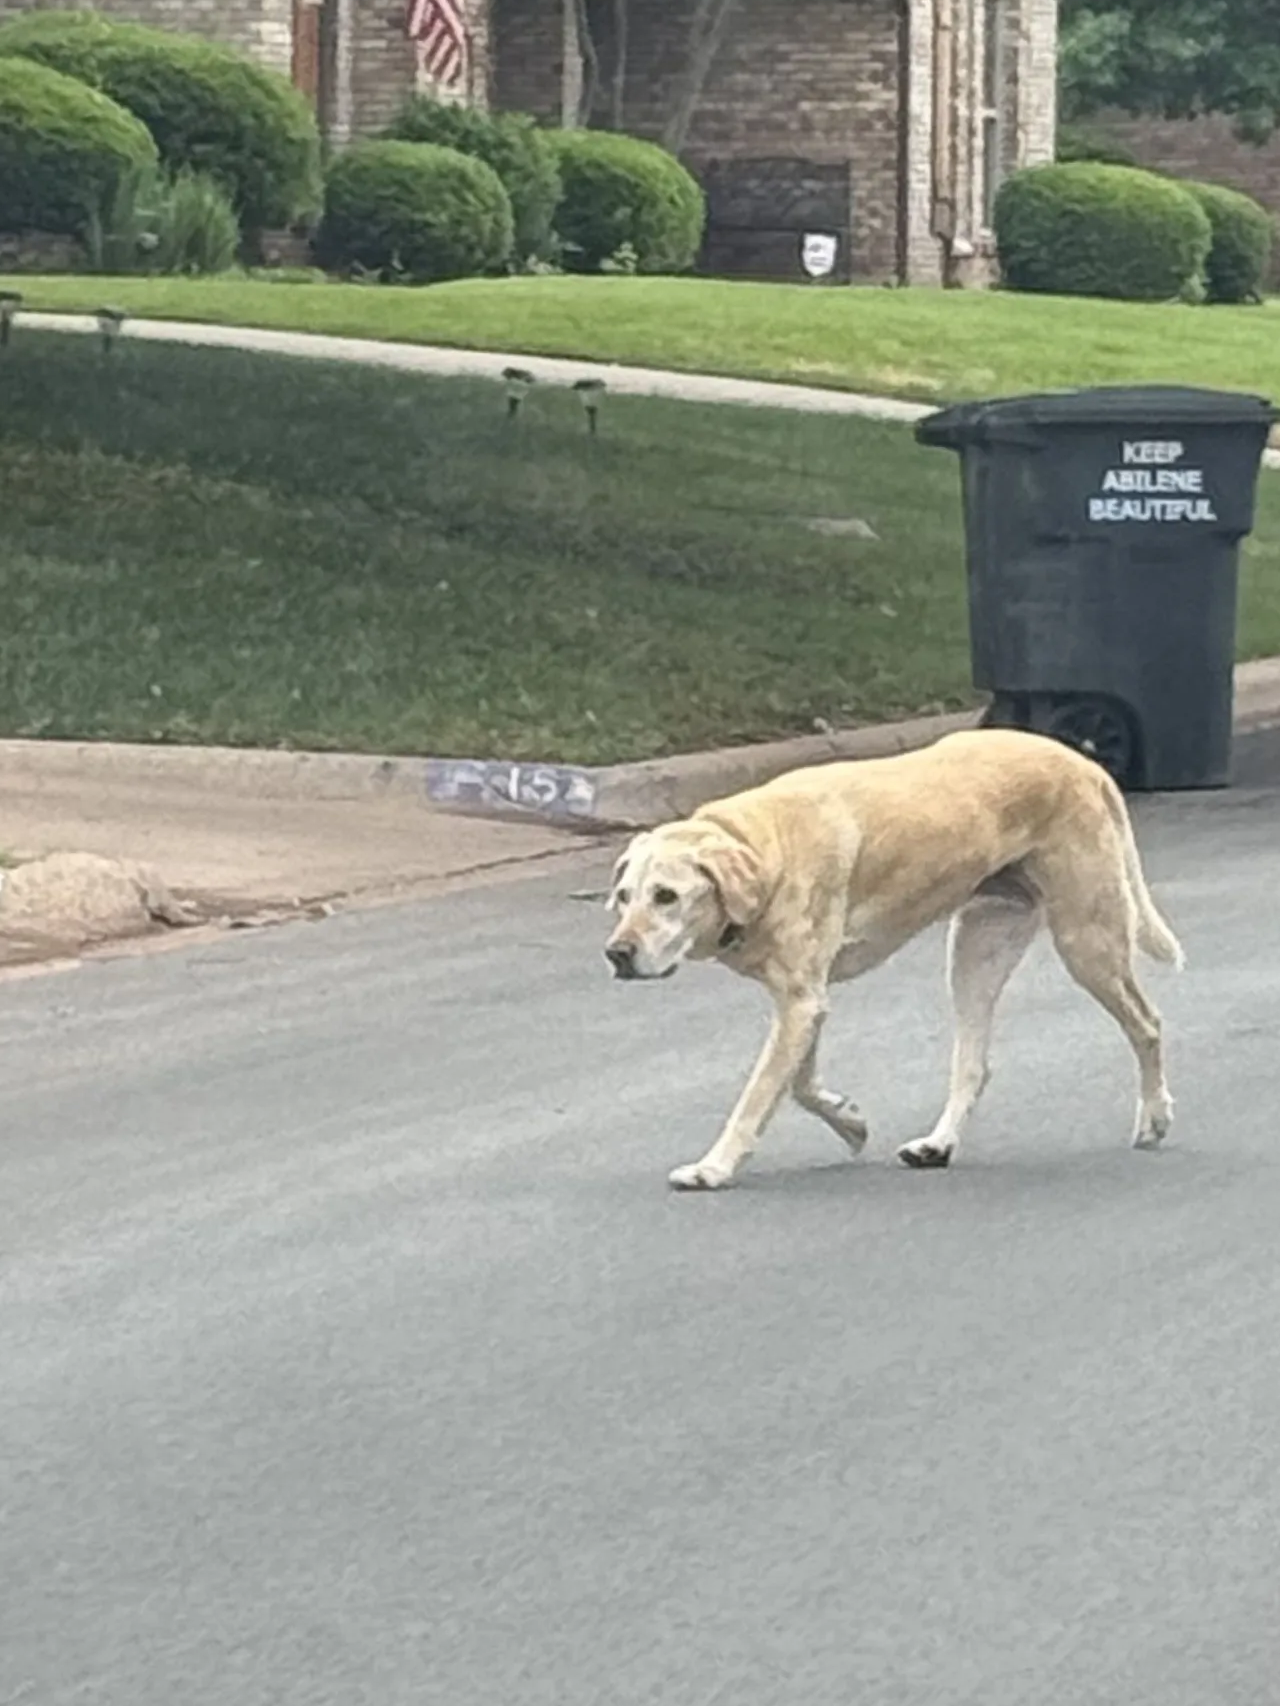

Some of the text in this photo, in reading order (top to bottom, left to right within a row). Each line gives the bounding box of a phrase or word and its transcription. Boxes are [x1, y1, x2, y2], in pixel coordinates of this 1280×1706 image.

[1123, 440, 1183, 464] KEEP
[1102, 469, 1203, 493] ABILENE
[1088, 497, 1217, 522] BEAUTIFUL
